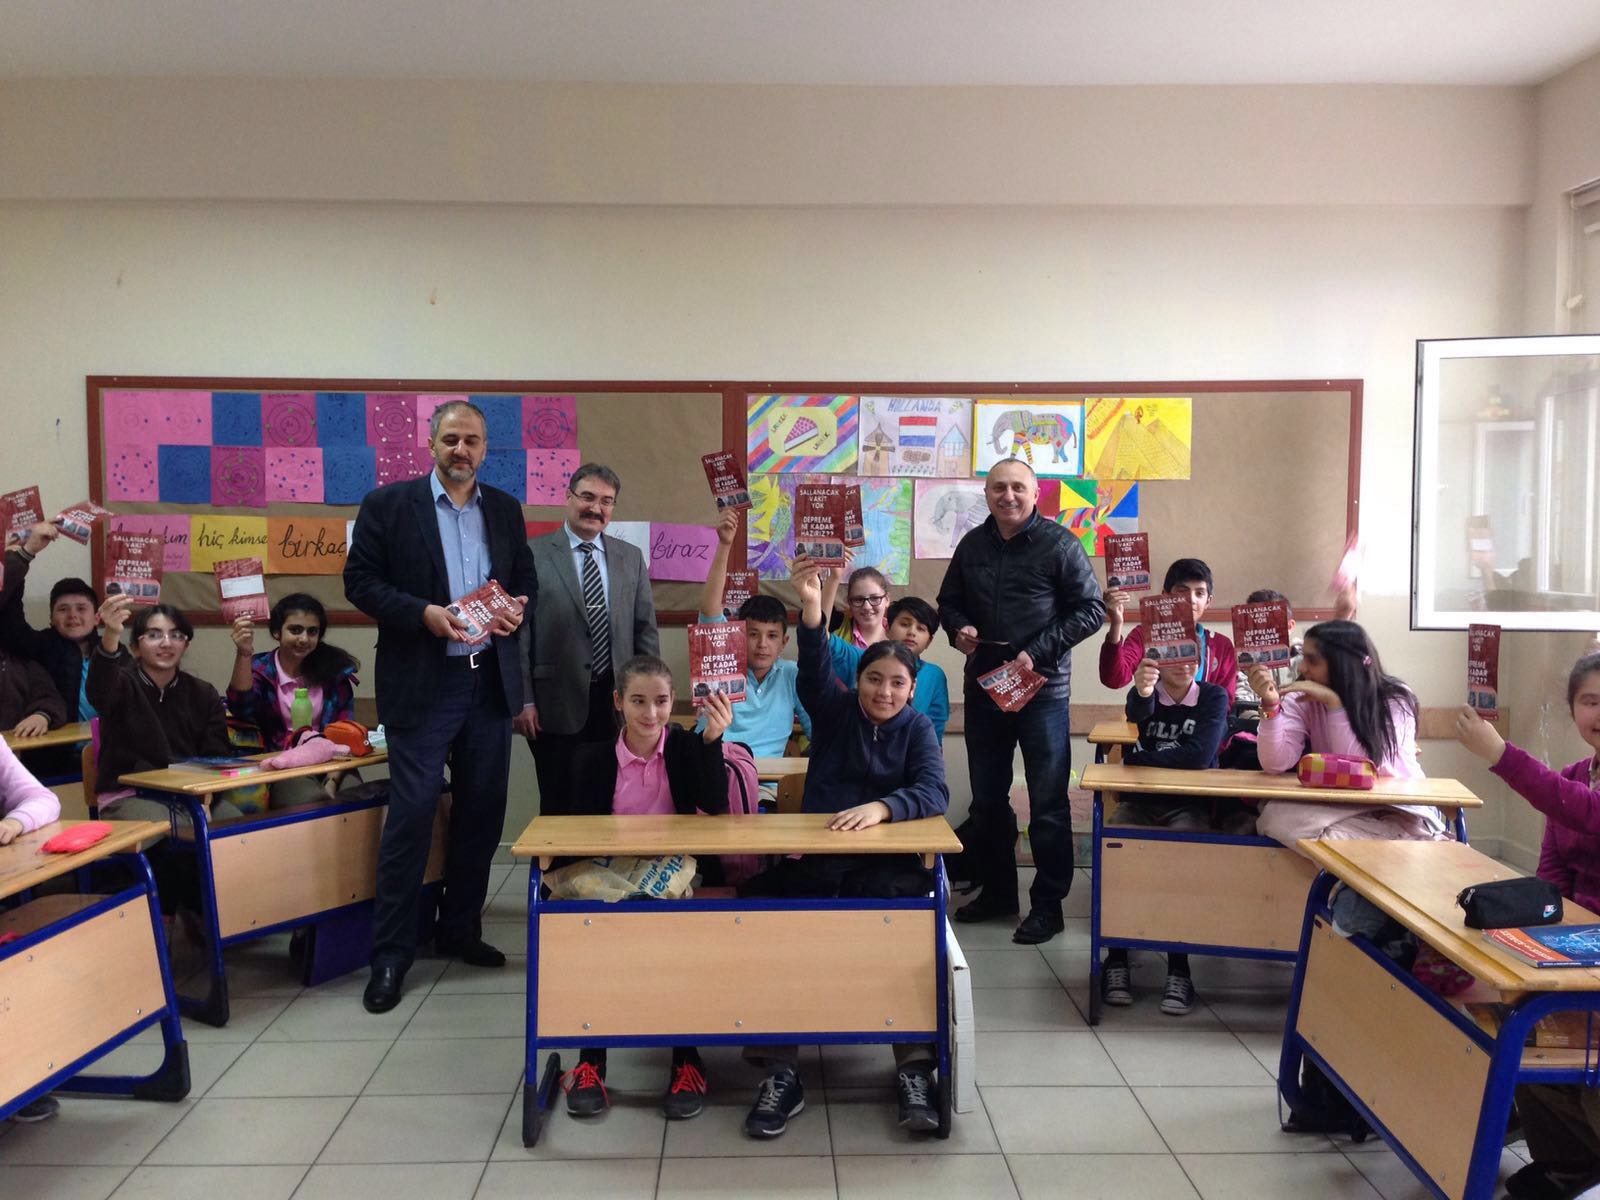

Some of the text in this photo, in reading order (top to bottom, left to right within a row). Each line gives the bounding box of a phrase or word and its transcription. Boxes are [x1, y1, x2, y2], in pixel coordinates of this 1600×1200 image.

[803, 516, 832, 524] DEPREME
[810, 523, 834, 531] KADAR
[198, 523, 225, 549] hiç
[228, 526, 268, 545] kimse
[278, 524, 347, 558] birkaç
[651, 531, 709, 560] biraz
[1237, 605, 1281, 615] SALLANACAK
[695, 626, 741, 636] SALLANACAK
[1245, 628, 1276, 636] DEPREME
[712, 640, 726, 648] YOK
[703, 653, 735, 663] DEPREME
[701, 660, 737, 670] NE KADAR
